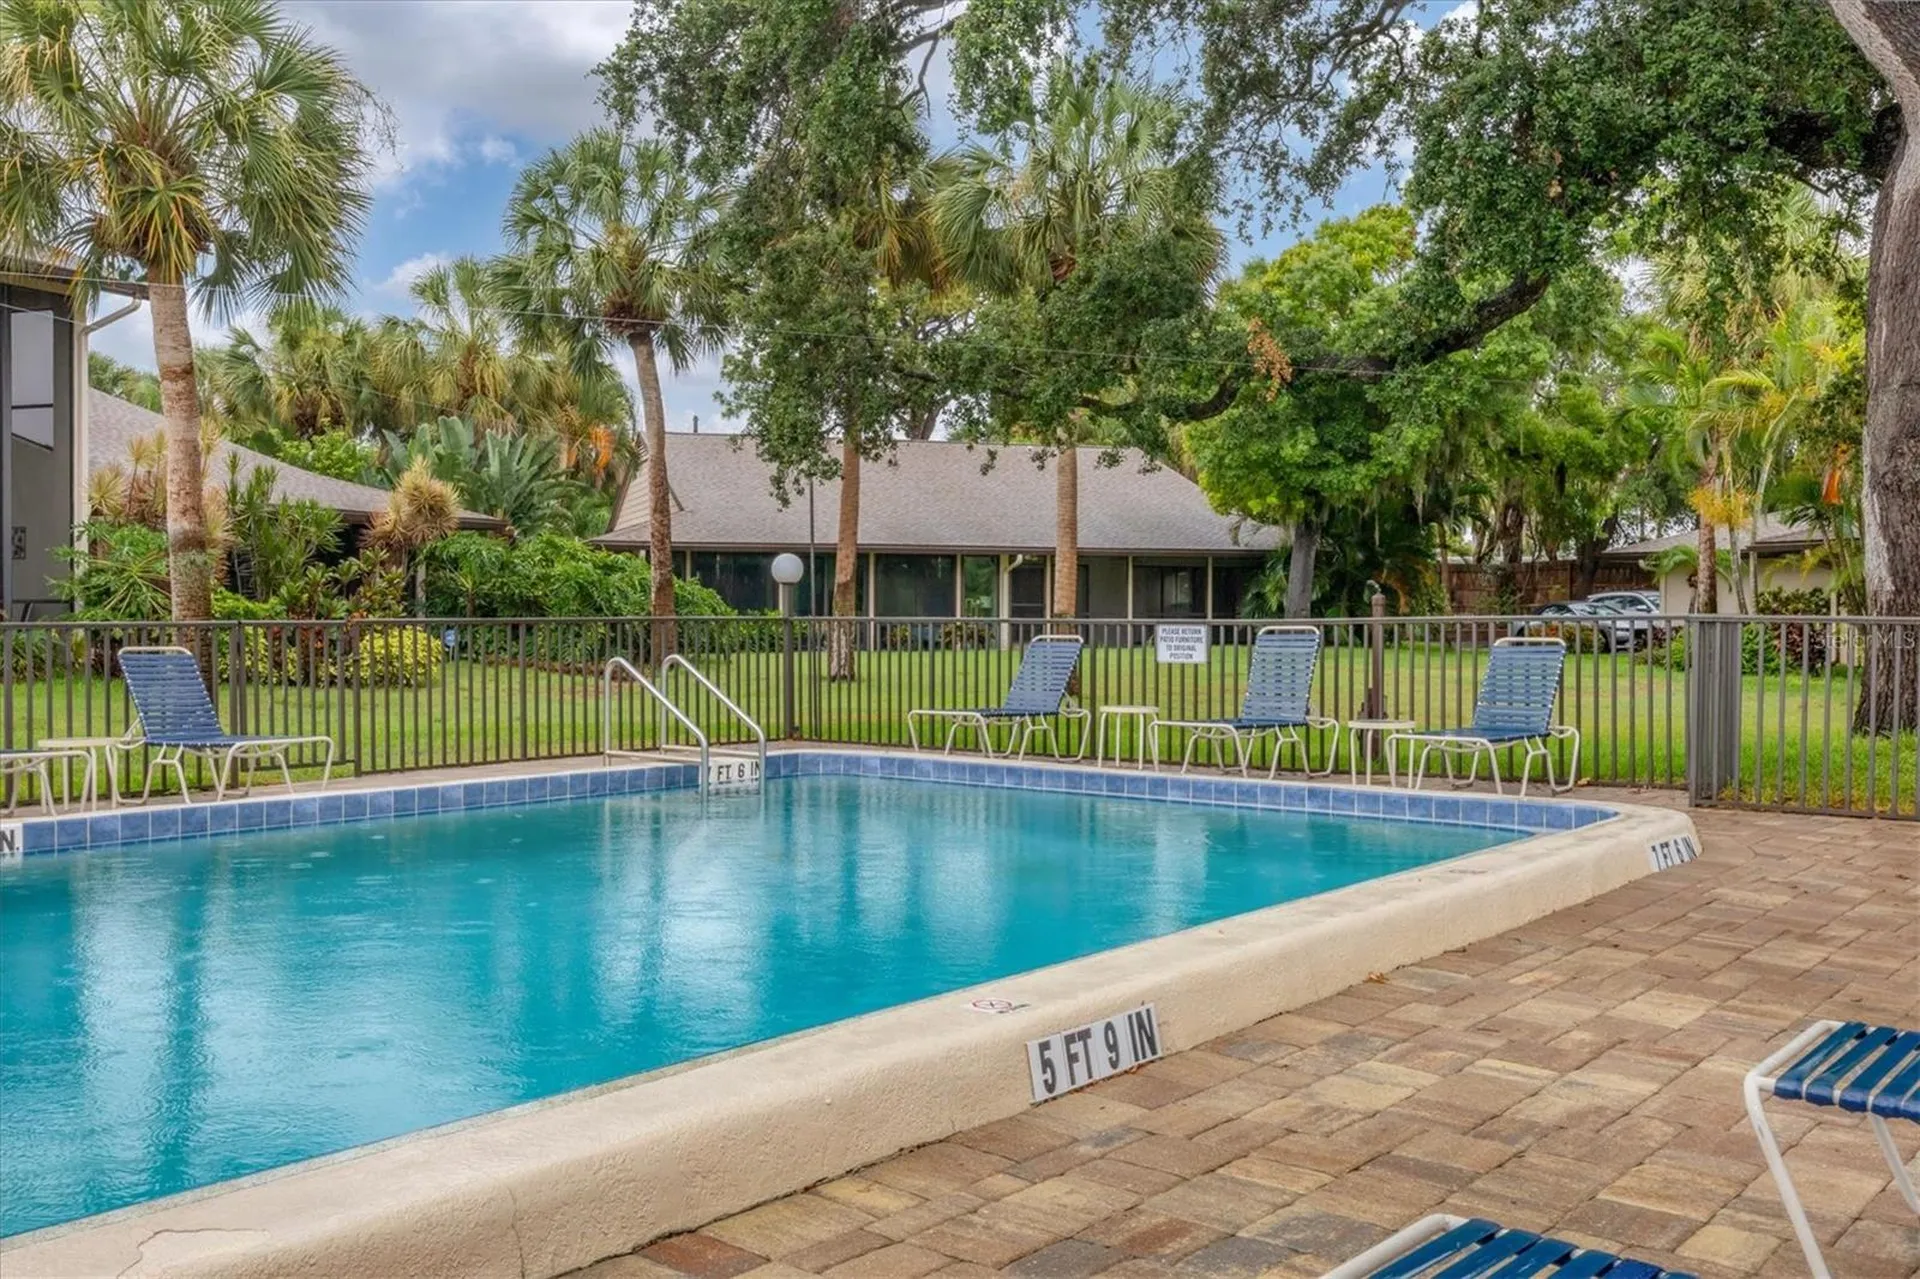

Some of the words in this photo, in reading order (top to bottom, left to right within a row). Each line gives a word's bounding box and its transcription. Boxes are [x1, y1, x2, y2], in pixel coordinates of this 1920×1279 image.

[1173, 644, 1197, 652] ORIGINAL
[718, 764, 732, 780] FT
[737, 763, 745, 778] 6
[1660, 841, 1674, 868] FT
[1681, 835, 1698, 862] IN
[1038, 1040, 1057, 1094] 5
[1064, 1028, 1093, 1086] FT
[1104, 1021, 1120, 1070] 9
[1127, 1008, 1158, 1062] IN
